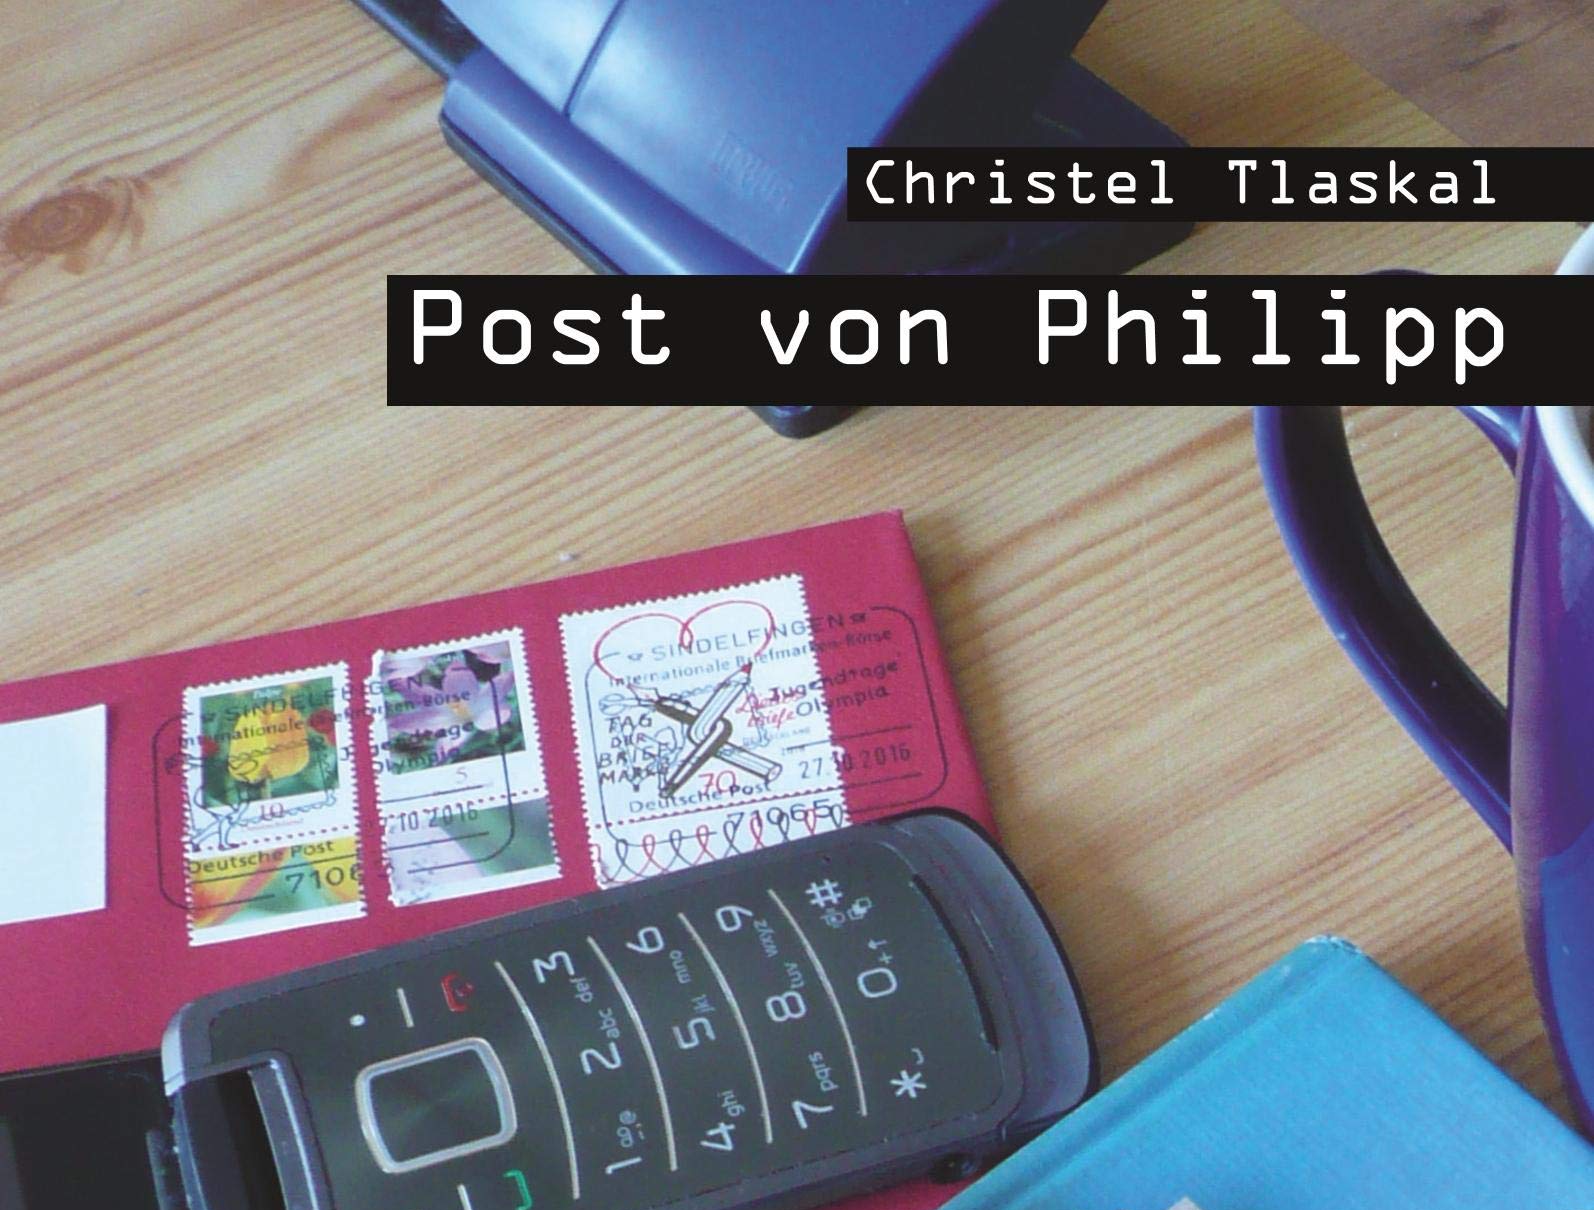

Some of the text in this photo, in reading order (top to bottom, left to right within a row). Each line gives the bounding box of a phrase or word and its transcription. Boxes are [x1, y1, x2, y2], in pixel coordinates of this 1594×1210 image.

[290, 839, 335, 859] Post
[714, 904, 754, 933] 9
[626, 925, 665, 955] 6
[765, 991, 808, 1023] 8
[672, 1016, 717, 1050] 5
[580, 1042, 623, 1077] 2
[791, 1100, 835, 1131] 7
[700, 1121, 737, 1152] 4
